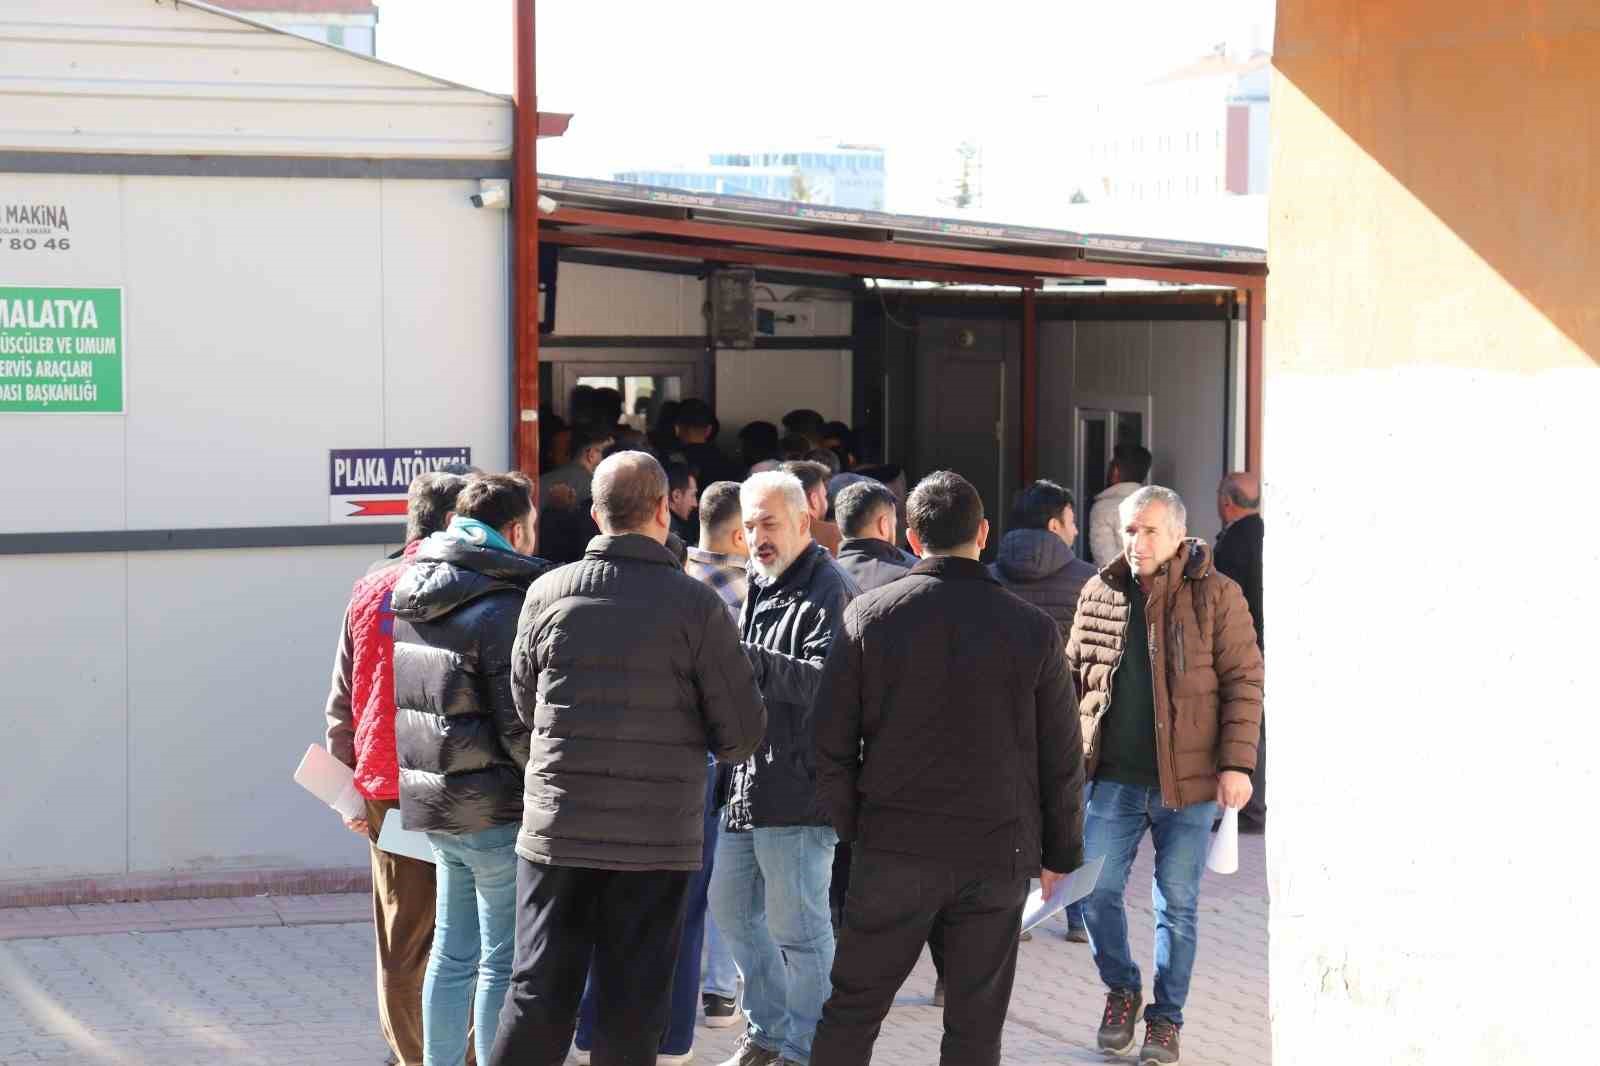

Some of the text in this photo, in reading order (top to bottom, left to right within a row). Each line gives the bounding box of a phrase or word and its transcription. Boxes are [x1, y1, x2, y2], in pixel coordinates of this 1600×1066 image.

[10, 238, 36, 250] 80
[43, 238, 70, 250] 46
[56, 337, 72, 354] VE
[75, 337, 116, 354] UMUM
[36, 360, 92, 382] ARAÇLARI
[26, 380, 97, 406] BAŞKANLIĞI
[334, 458, 387, 487] PLAKA
